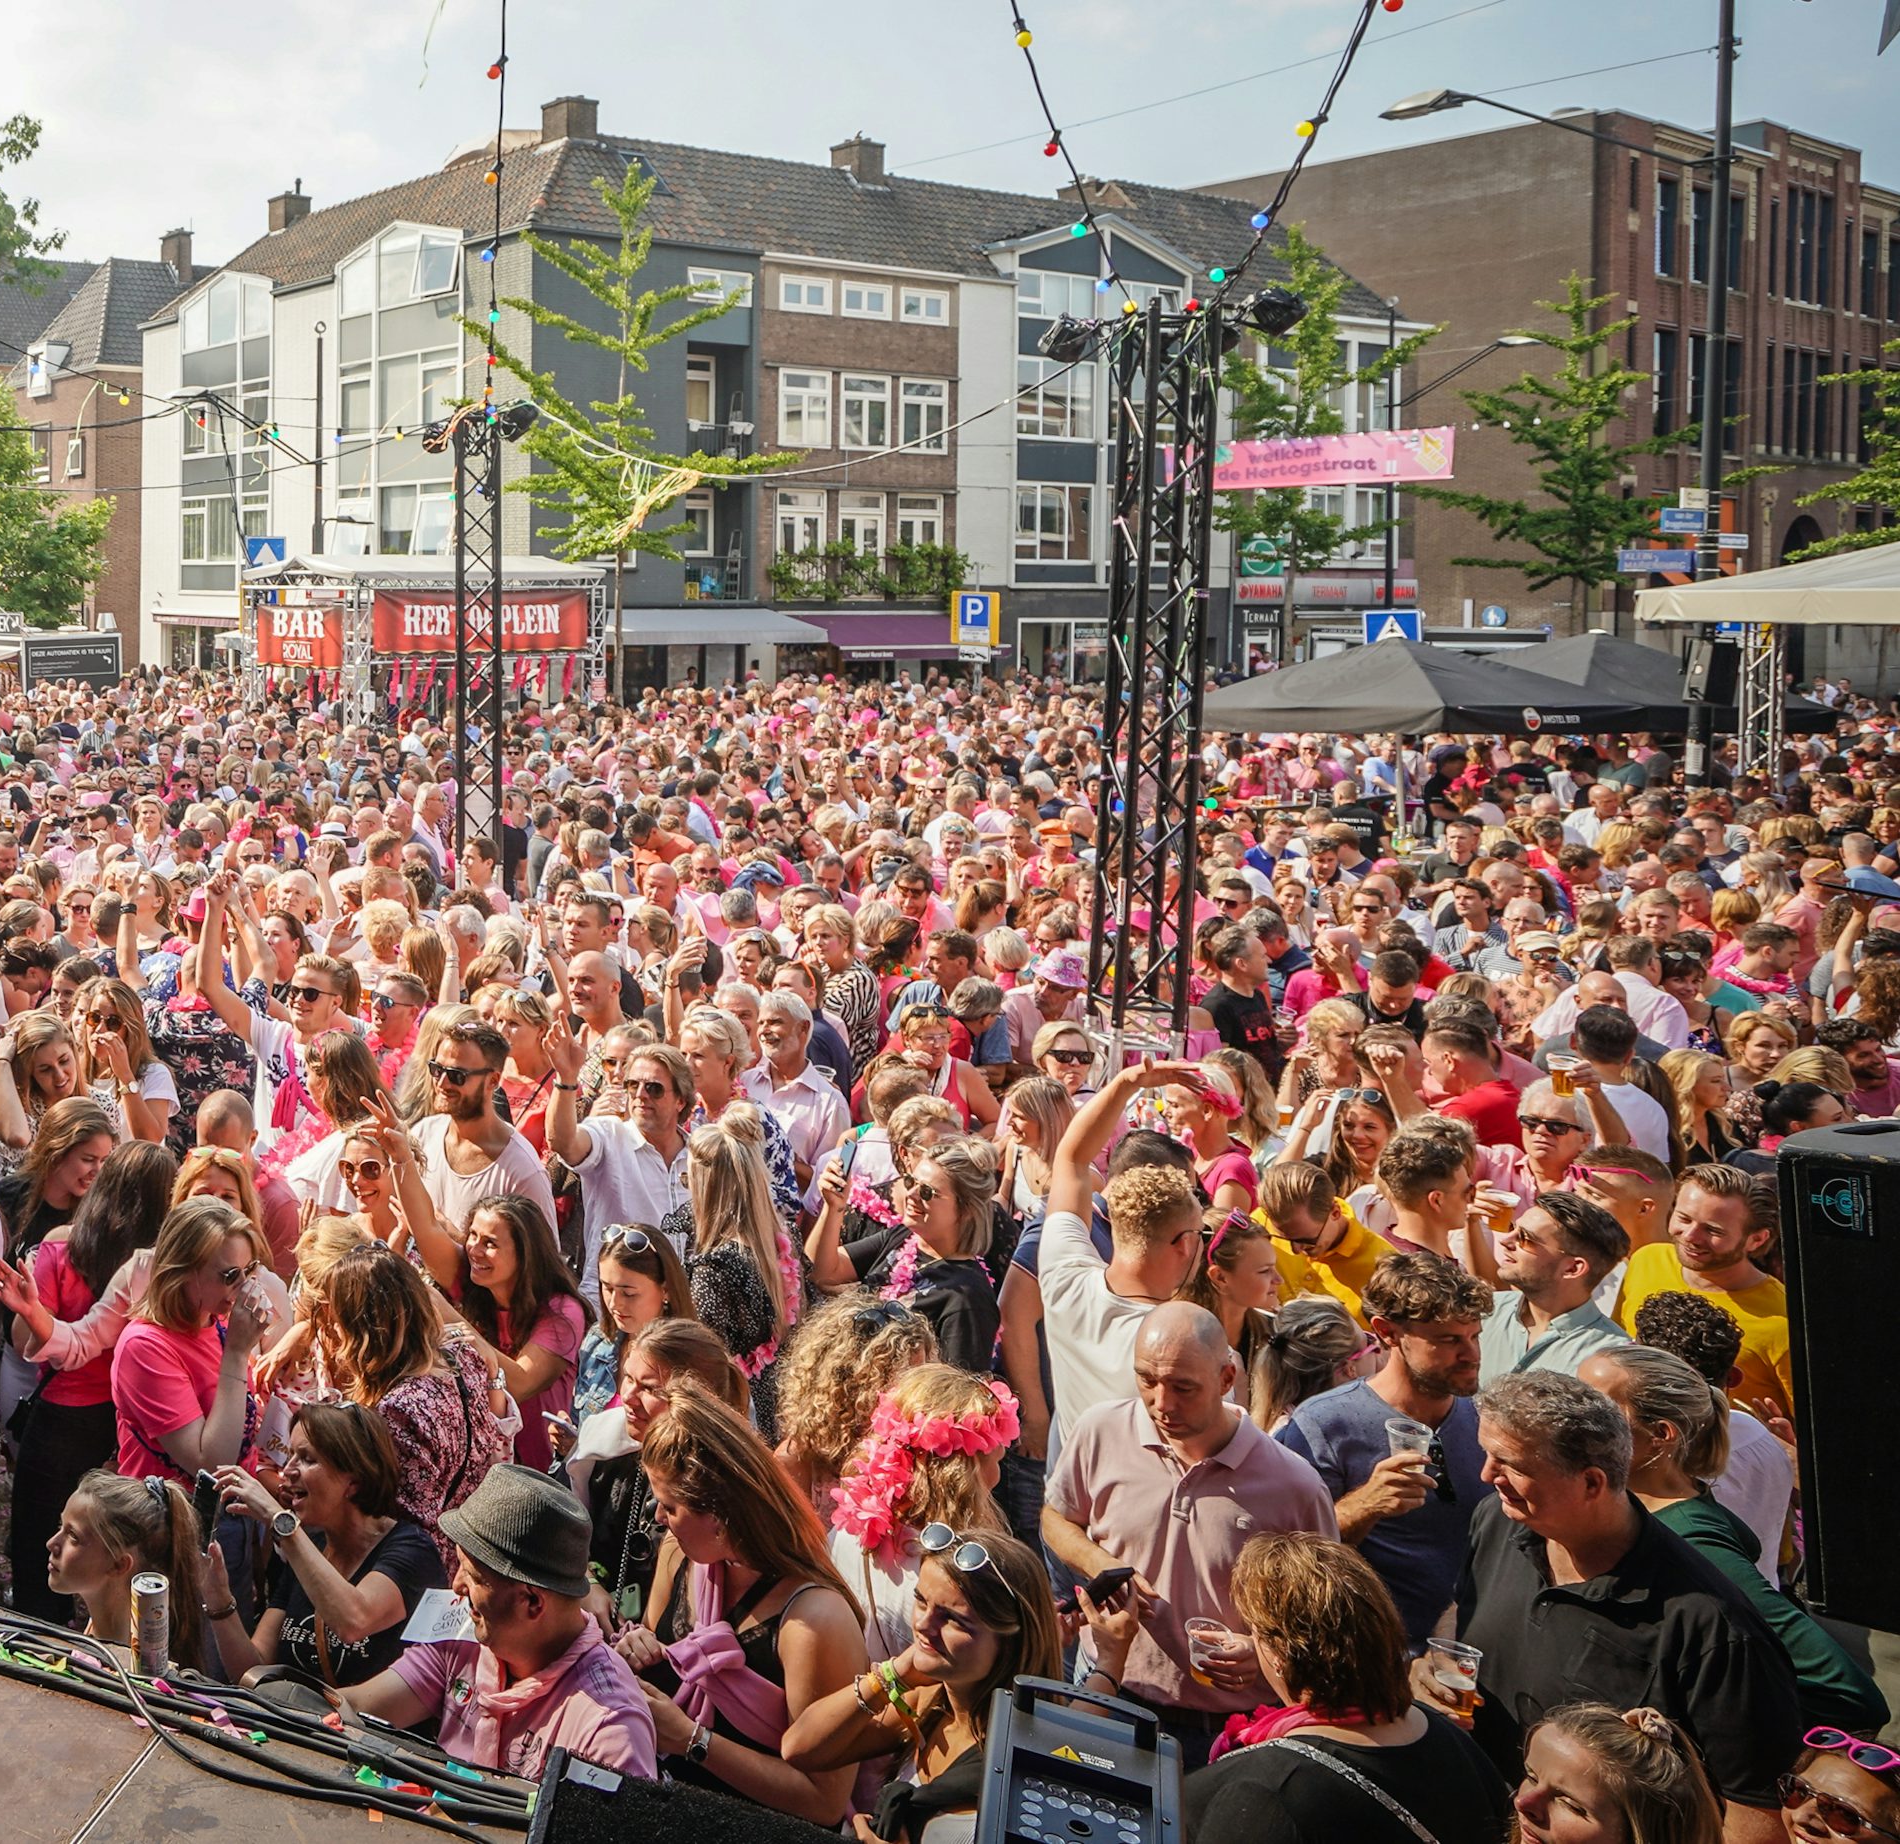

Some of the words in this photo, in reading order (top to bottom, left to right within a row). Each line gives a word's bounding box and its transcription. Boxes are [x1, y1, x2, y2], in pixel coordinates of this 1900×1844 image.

[1248, 445, 1322, 465] welkom
[1217, 468, 1241, 482] de
[1245, 457, 1378, 482] Hertogstraat
[1249, 584, 1283, 599] YAMAHA
[966, 598, 984, 624] P
[272, 608, 325, 639] BAR
[282, 642, 314, 660] ROYAL
[442, 1606, 469, 1621] GRAN
[586, 1768, 599, 1782] 4
